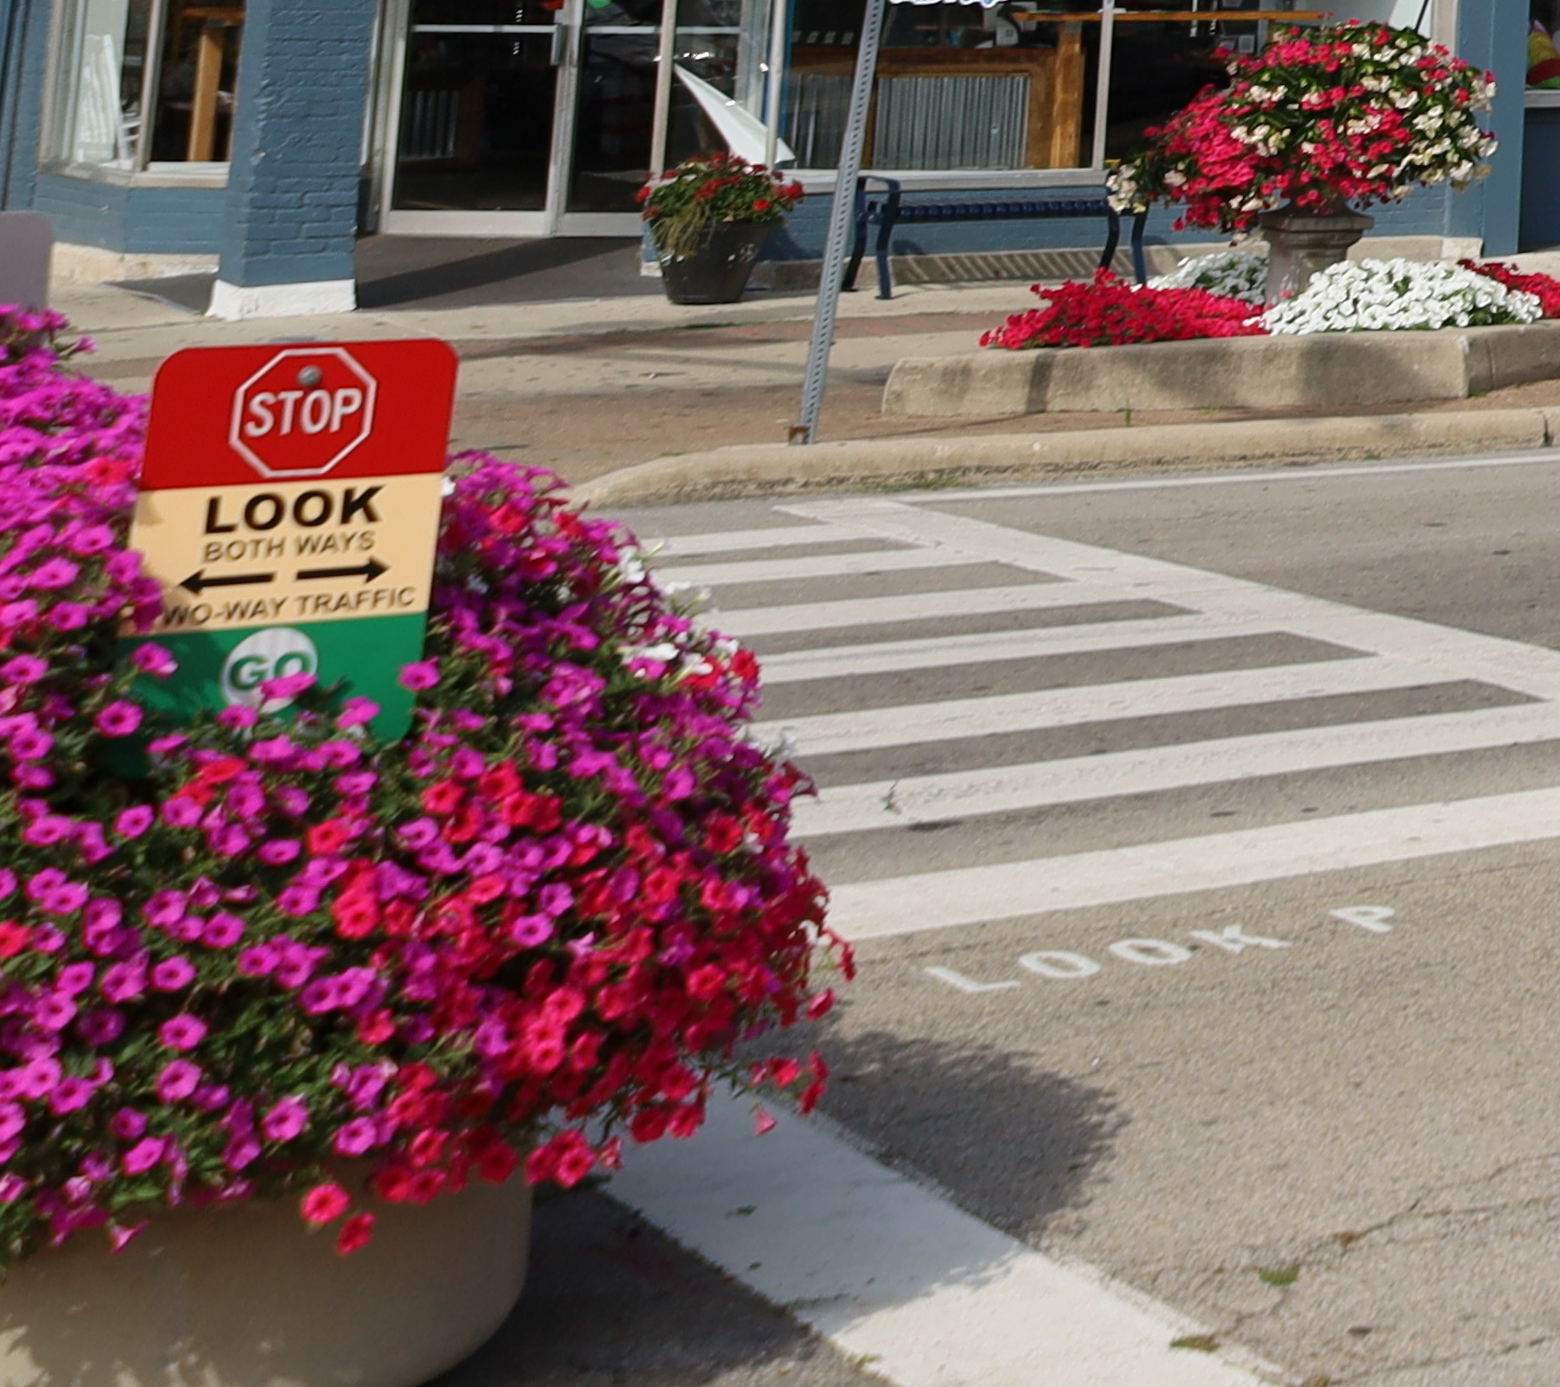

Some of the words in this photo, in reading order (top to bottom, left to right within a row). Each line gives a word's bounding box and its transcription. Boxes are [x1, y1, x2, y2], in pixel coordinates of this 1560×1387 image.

[243, 387, 363, 439] STOP
[203, 484, 386, 536] LOOK
[203, 536, 286, 563] BOTH
[295, 530, 377, 556] WAYS
[163, 595, 289, 627] WO-WAY
[296, 585, 418, 613] TRAFFIC
[924, 924, 1294, 994] LOOK
